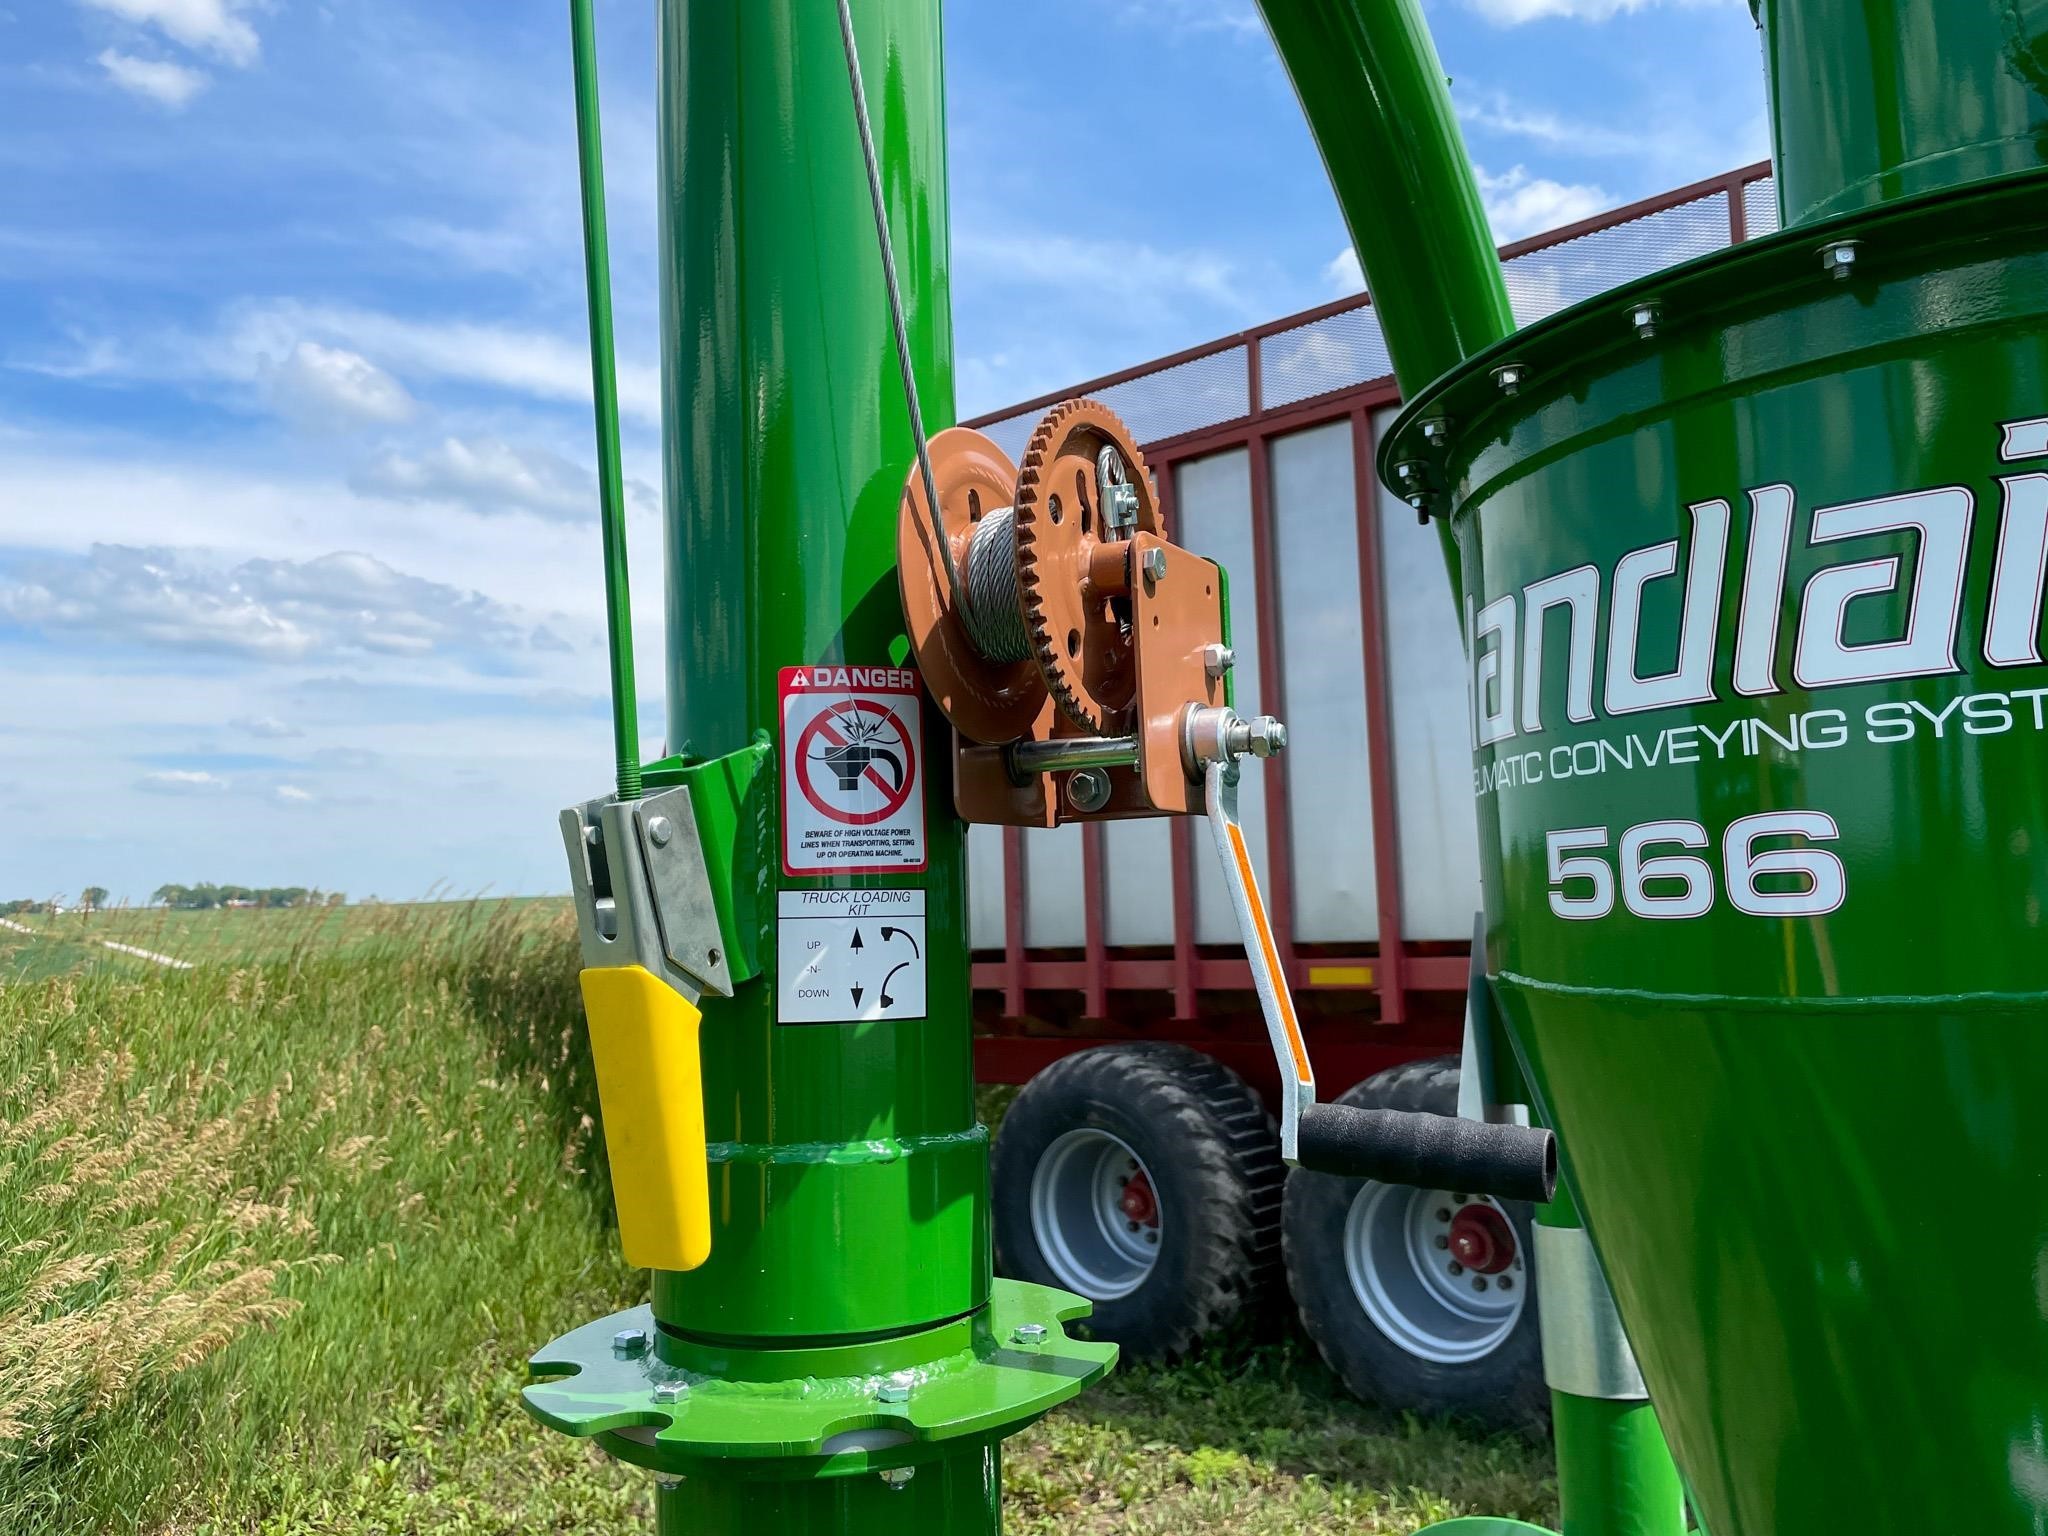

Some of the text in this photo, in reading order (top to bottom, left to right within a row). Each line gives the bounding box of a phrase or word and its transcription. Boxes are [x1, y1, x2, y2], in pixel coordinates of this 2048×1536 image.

[813, 668, 914, 689] DANGER
[1549, 709, 1848, 779] CONVEYING
[805, 830, 833, 838] BEWARE
[844, 829, 861, 837] HIGH
[862, 829, 890, 837] VOLTAGE
[800, 841, 820, 849] LINES
[842, 839, 891, 847] TRANSPORTING,
[838, 850, 874, 858] OPERATING
[875, 849, 903, 857] MACHINE.
[1545, 810, 1848, 921] 566
[801, 891, 911, 904] TRUCK LOADING
[848, 904, 871, 916] KIT
[806, 941, 821, 950] UP
[798, 989, 830, 998] DOWN
